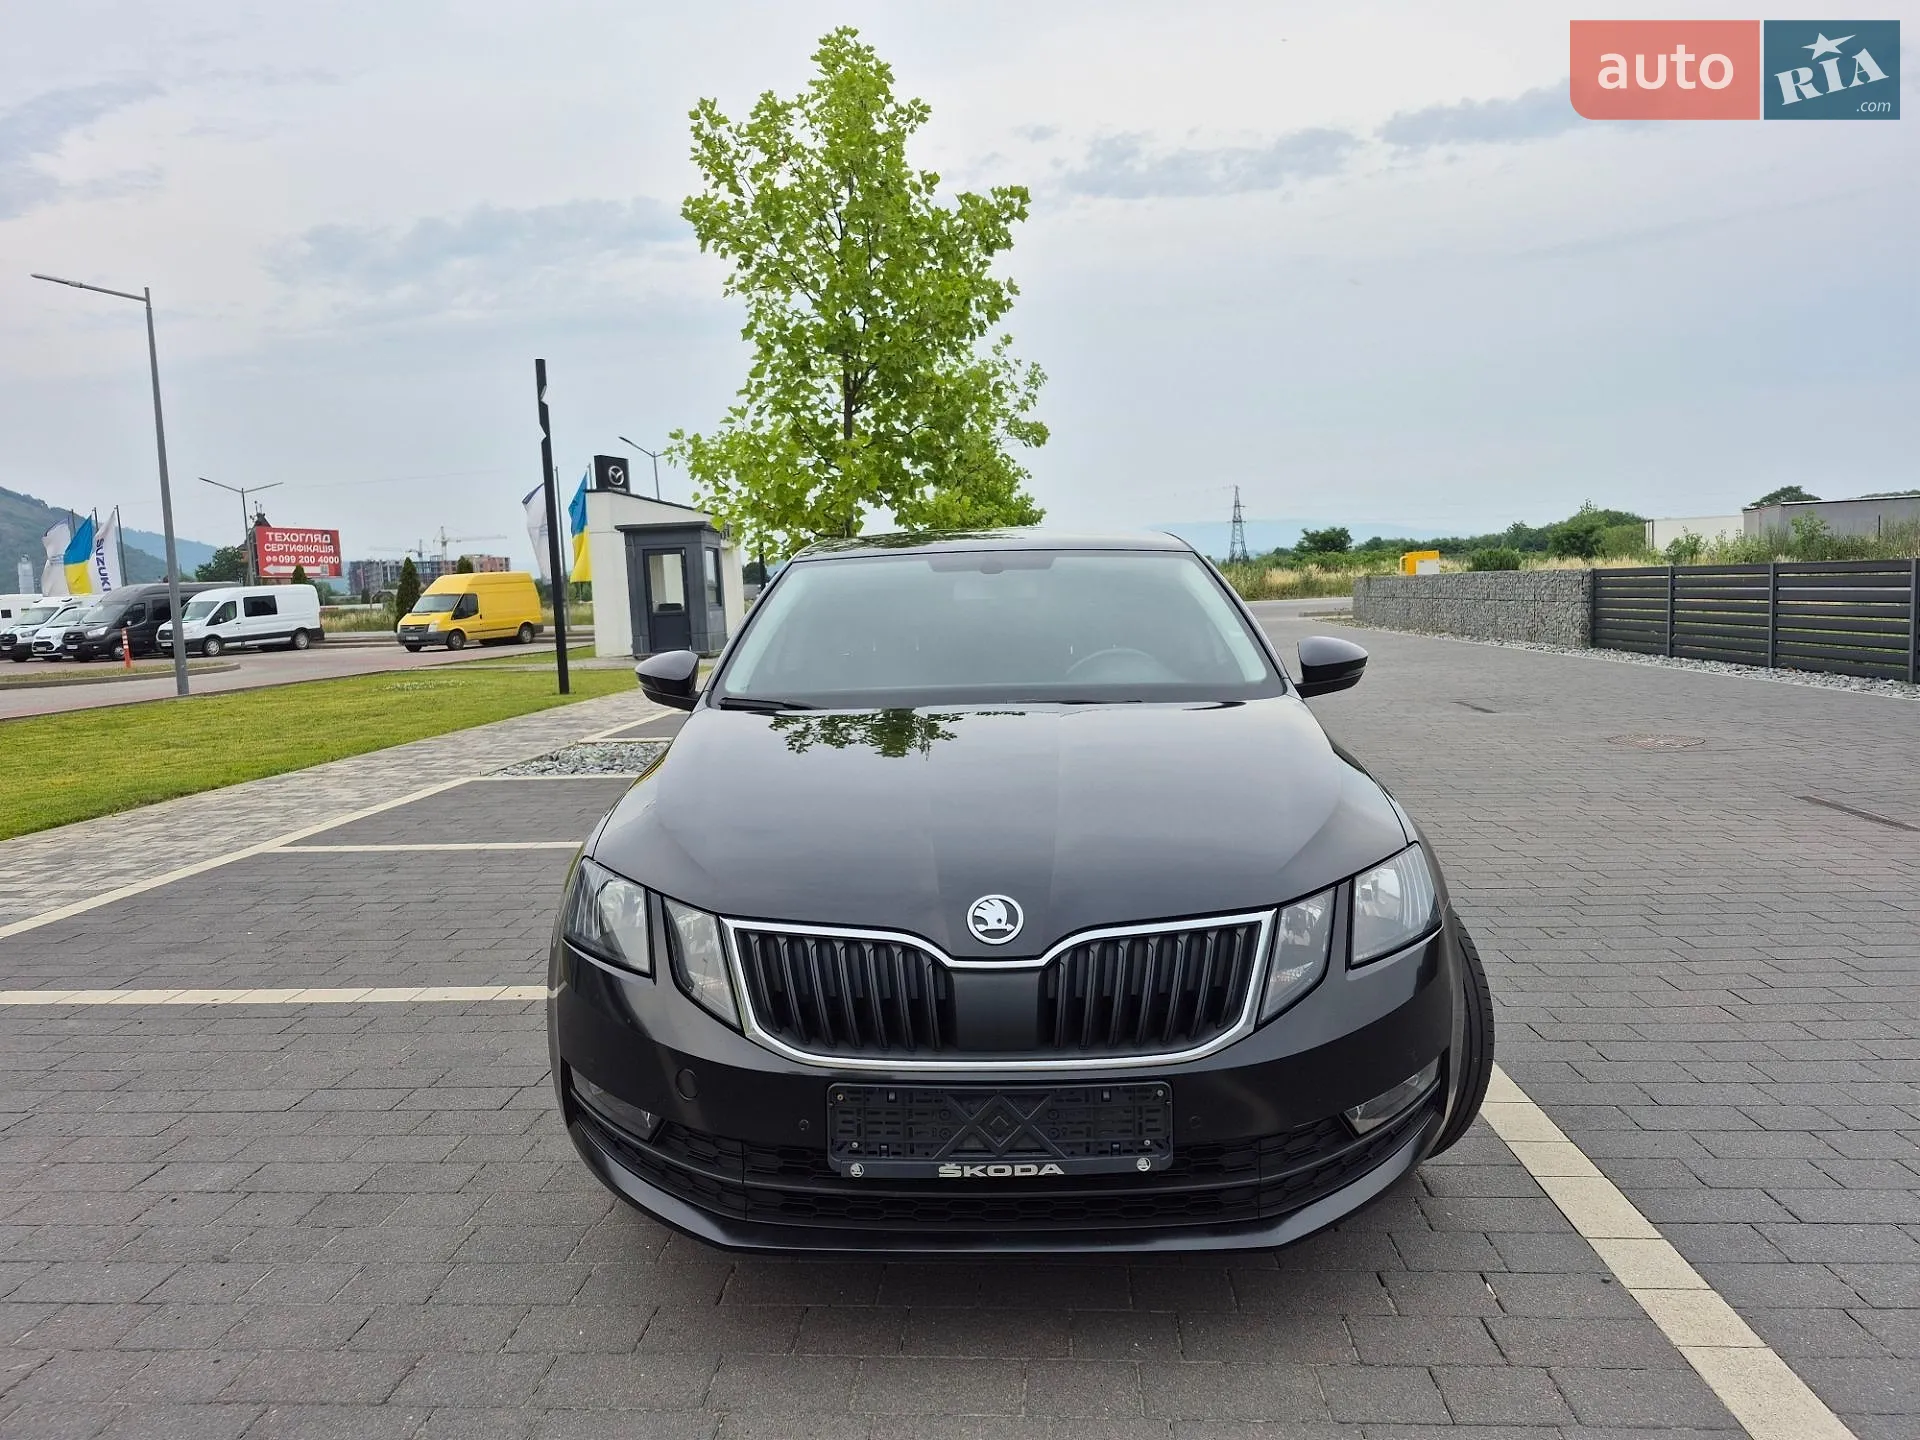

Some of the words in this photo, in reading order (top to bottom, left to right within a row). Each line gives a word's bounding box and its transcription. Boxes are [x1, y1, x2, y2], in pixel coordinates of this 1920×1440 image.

[265, 532, 331, 543] ТЕХОГЛЯД
[264, 543, 334, 553] СЕРТИФІКАЦІЯ
[96, 538, 111, 591] SUZUKI
[278, 555, 296, 564] 099
[298, 556, 315, 564] 200
[317, 556, 339, 564] 4000
[938, 1163, 1065, 1178] ŠKODA
